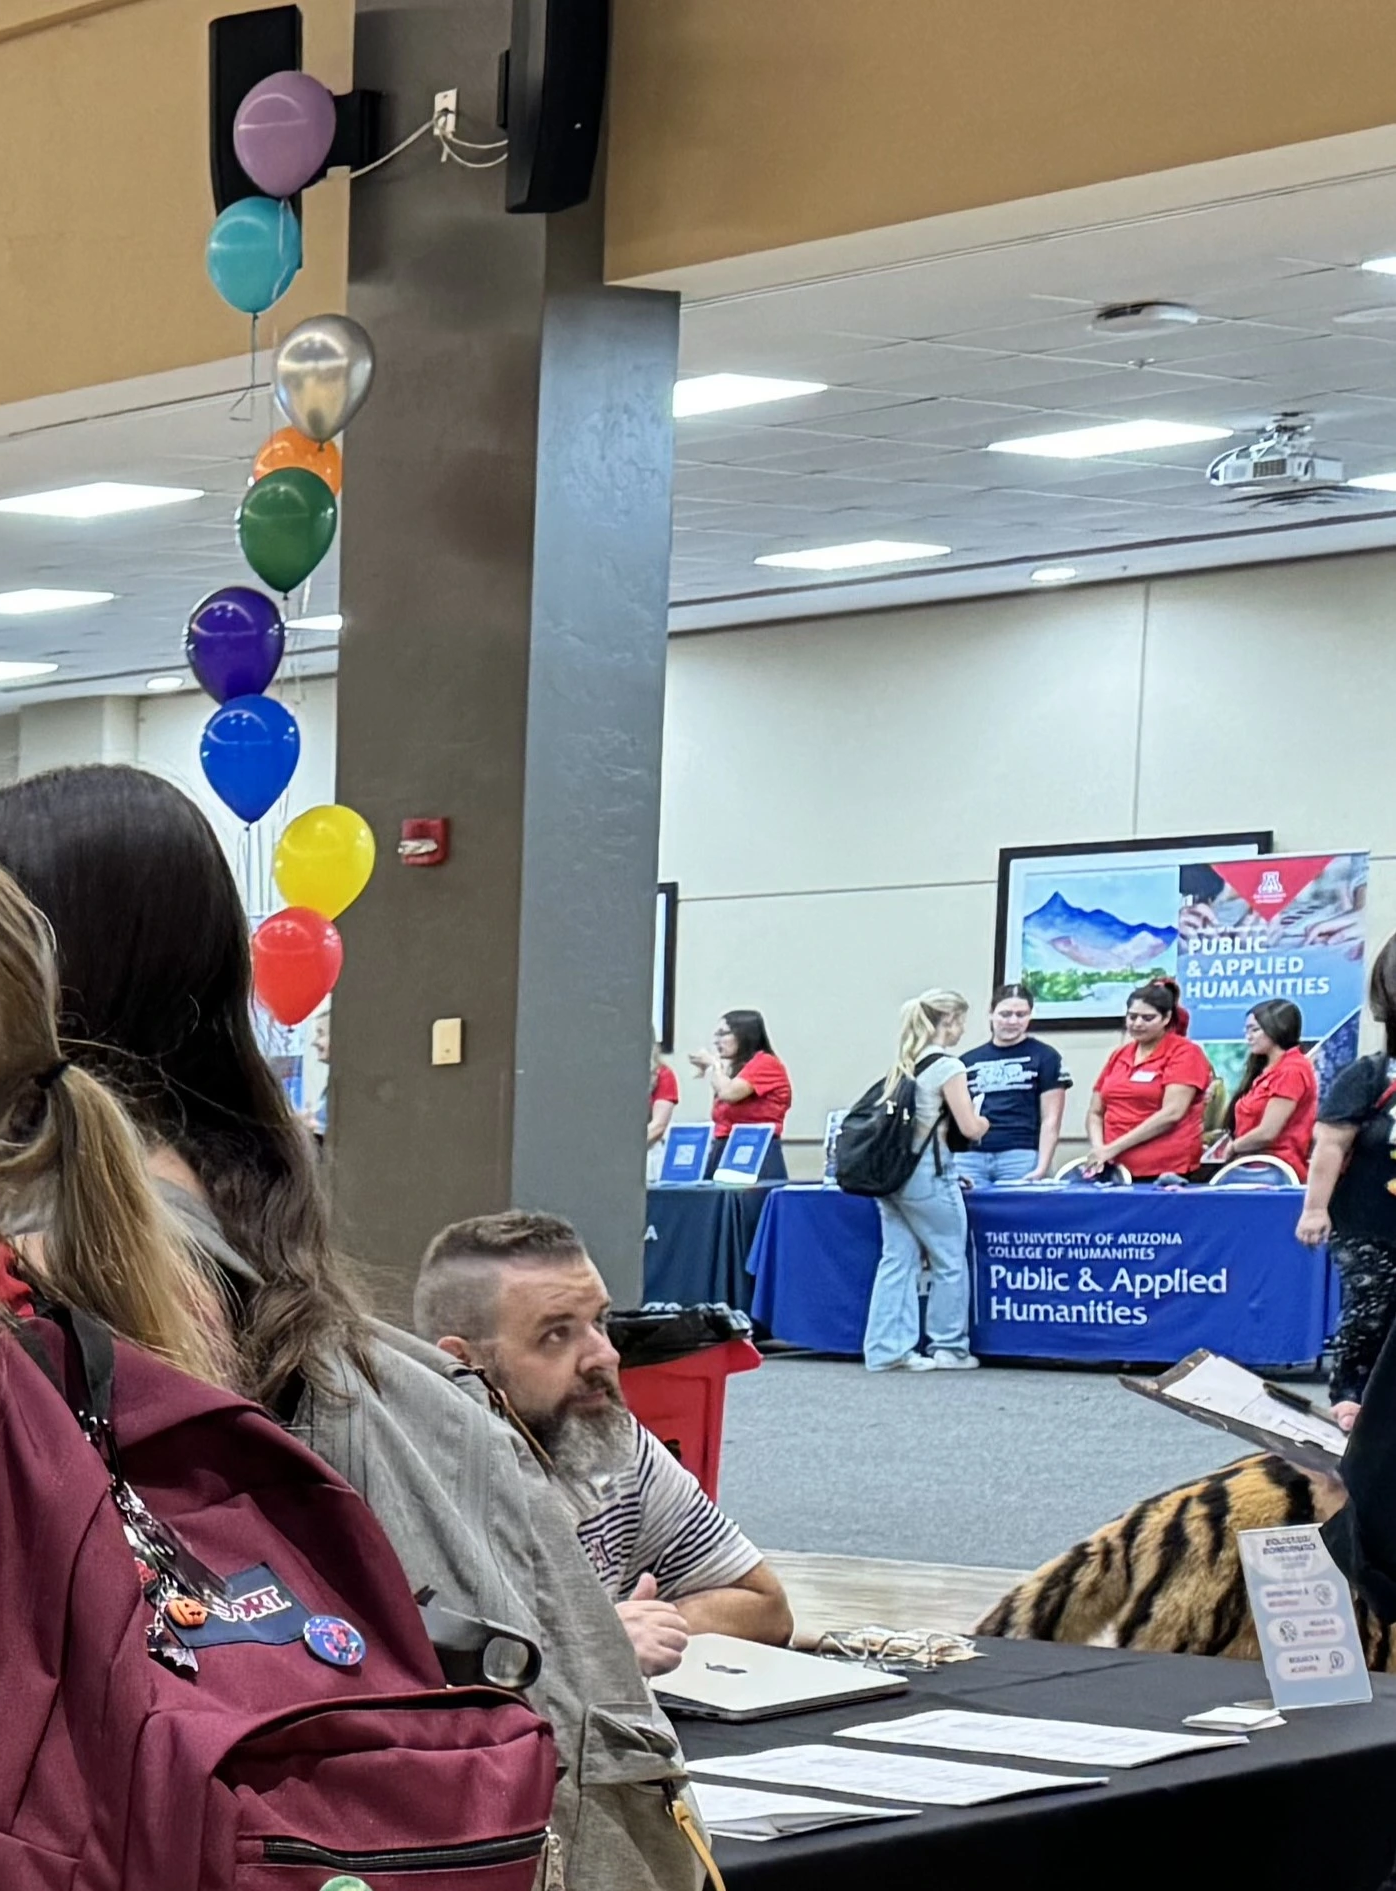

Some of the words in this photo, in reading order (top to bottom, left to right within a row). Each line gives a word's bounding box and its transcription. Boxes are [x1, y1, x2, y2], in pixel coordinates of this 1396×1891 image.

[1188, 936, 1268, 955] PUBLIC
[1186, 960, 1202, 978] &
[1209, 956, 1304, 977] APPLIED
[1185, 977, 1330, 998] HUMANITIES
[985, 1232, 1010, 1245] THE
[1013, 1232, 1092, 1245] UNIVERSITY
[1095, 1232, 1114, 1245] OF
[1118, 1232, 1182, 1245] ARIZONA
[987, 1247, 1042, 1259] COLLEGE
[1046, 1247, 1063, 1259] OF
[1068, 1247, 1155, 1260] HUMANITIES
[990, 1265, 1070, 1291] Public
[1077, 1267, 1104, 1292] &
[1109, 1267, 1227, 1299] Applied
[990, 1296, 1148, 1325] Humanities
